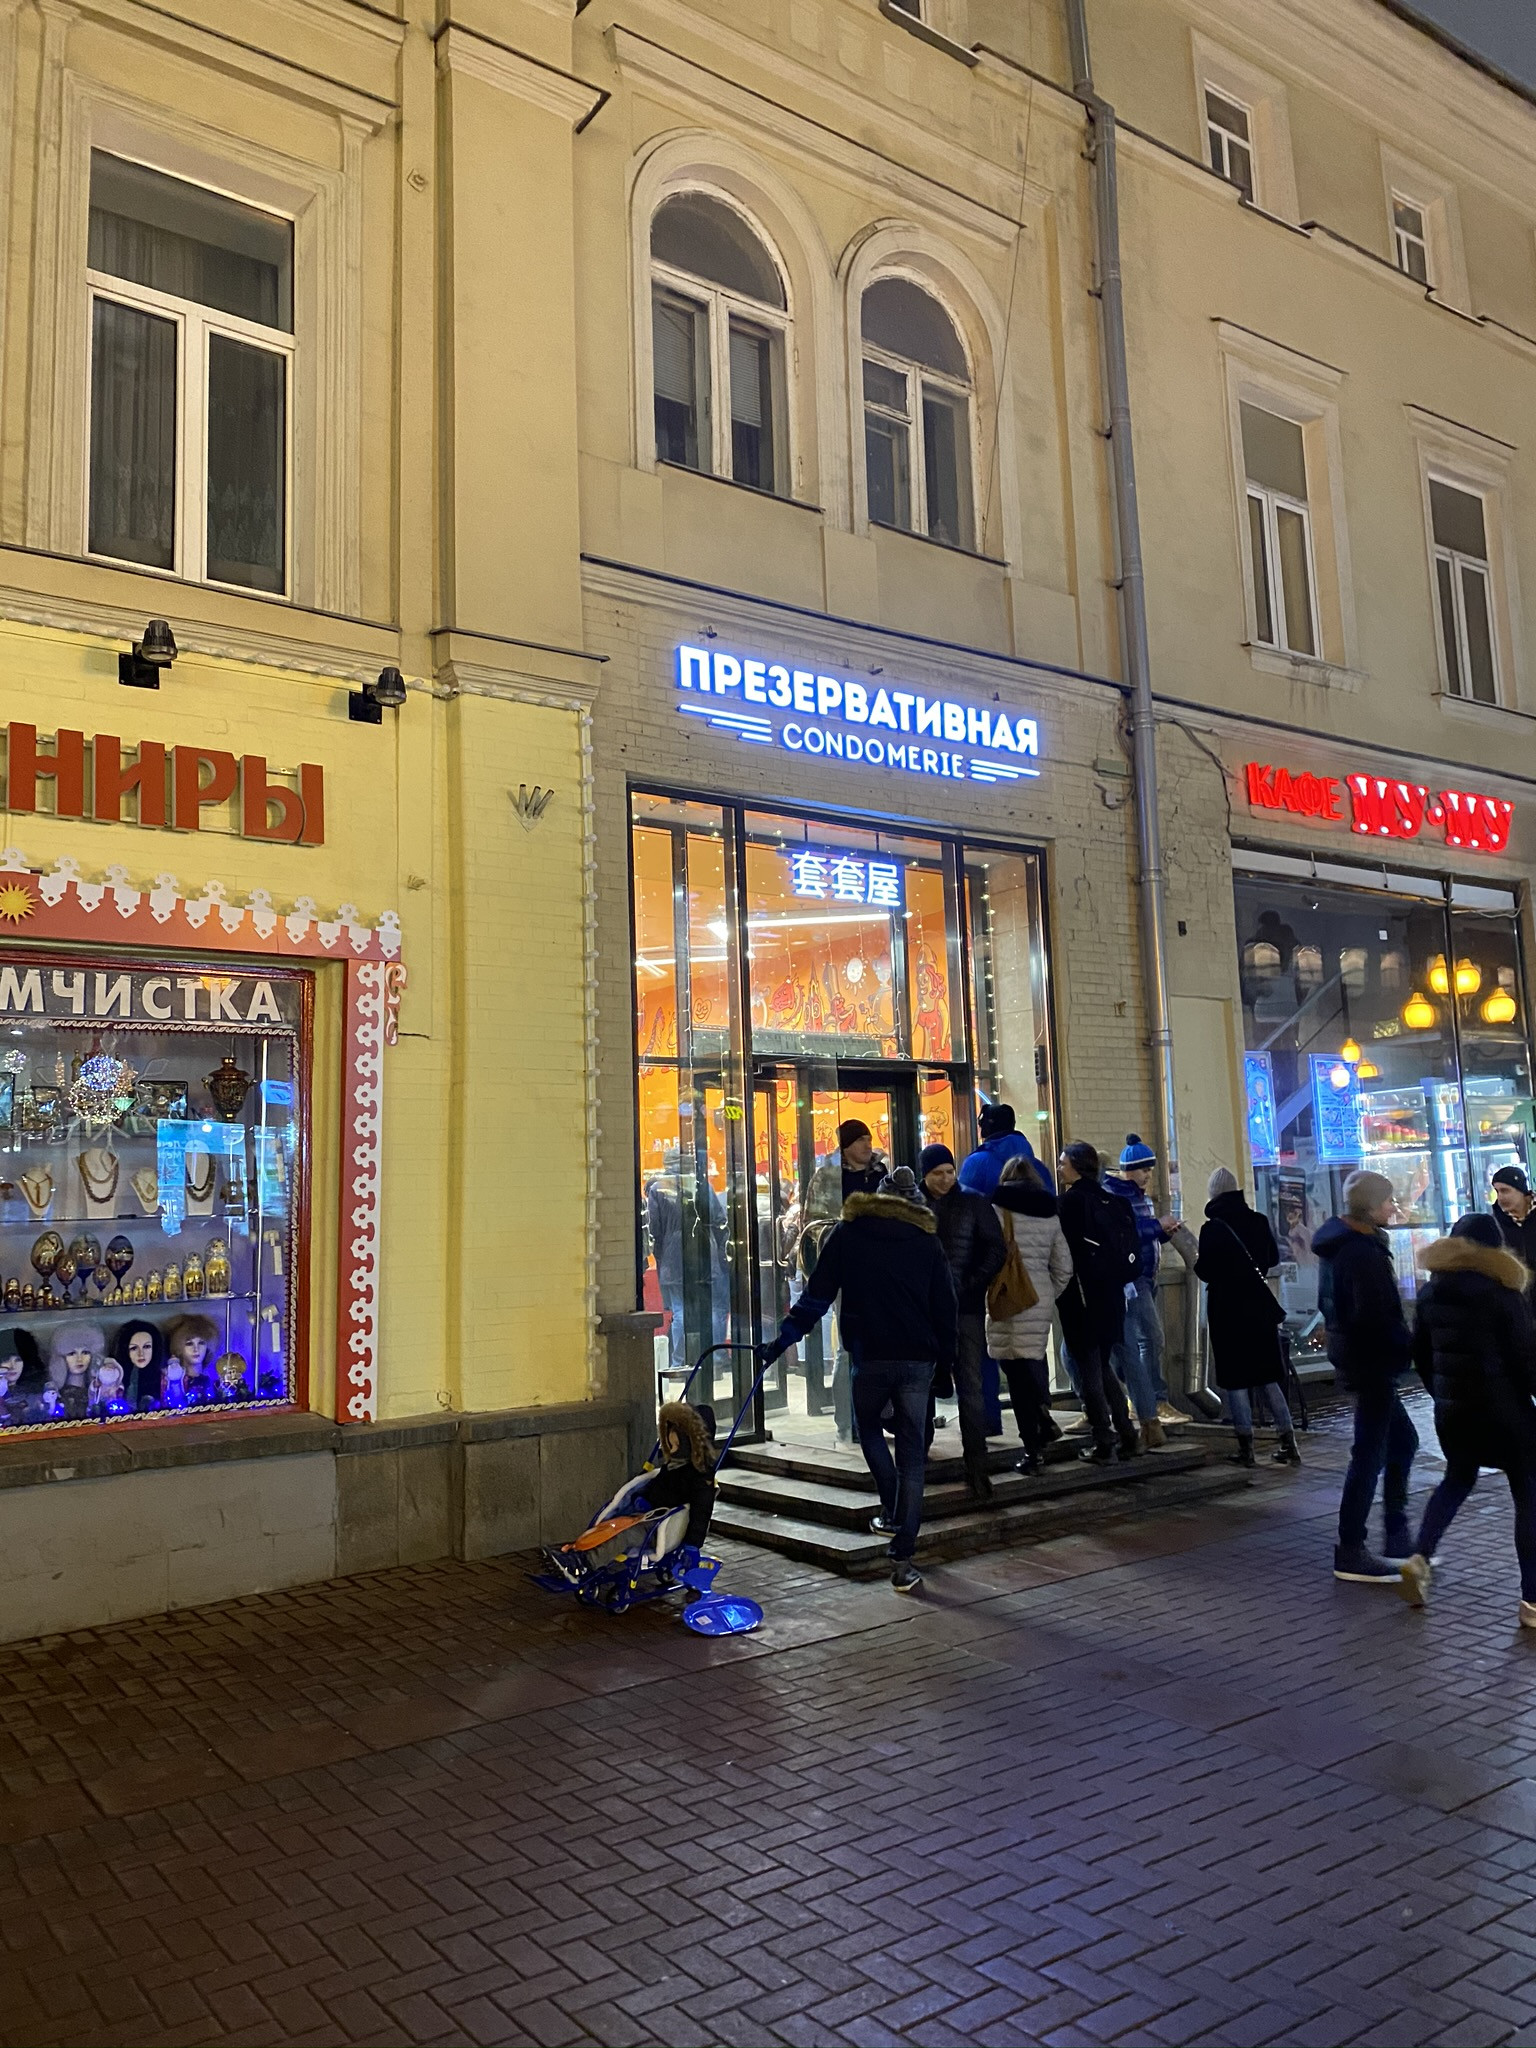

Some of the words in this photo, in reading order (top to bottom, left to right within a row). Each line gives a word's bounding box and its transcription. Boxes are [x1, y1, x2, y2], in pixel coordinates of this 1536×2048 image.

[678, 644, 1039, 756] ПРЕЗЕРВАТИВНАЯ
[782, 722, 966, 779] CONDOMERIE
[1247, 761, 1345, 821] КАФЕ
[791, 850, 901, 907] 套套屋
